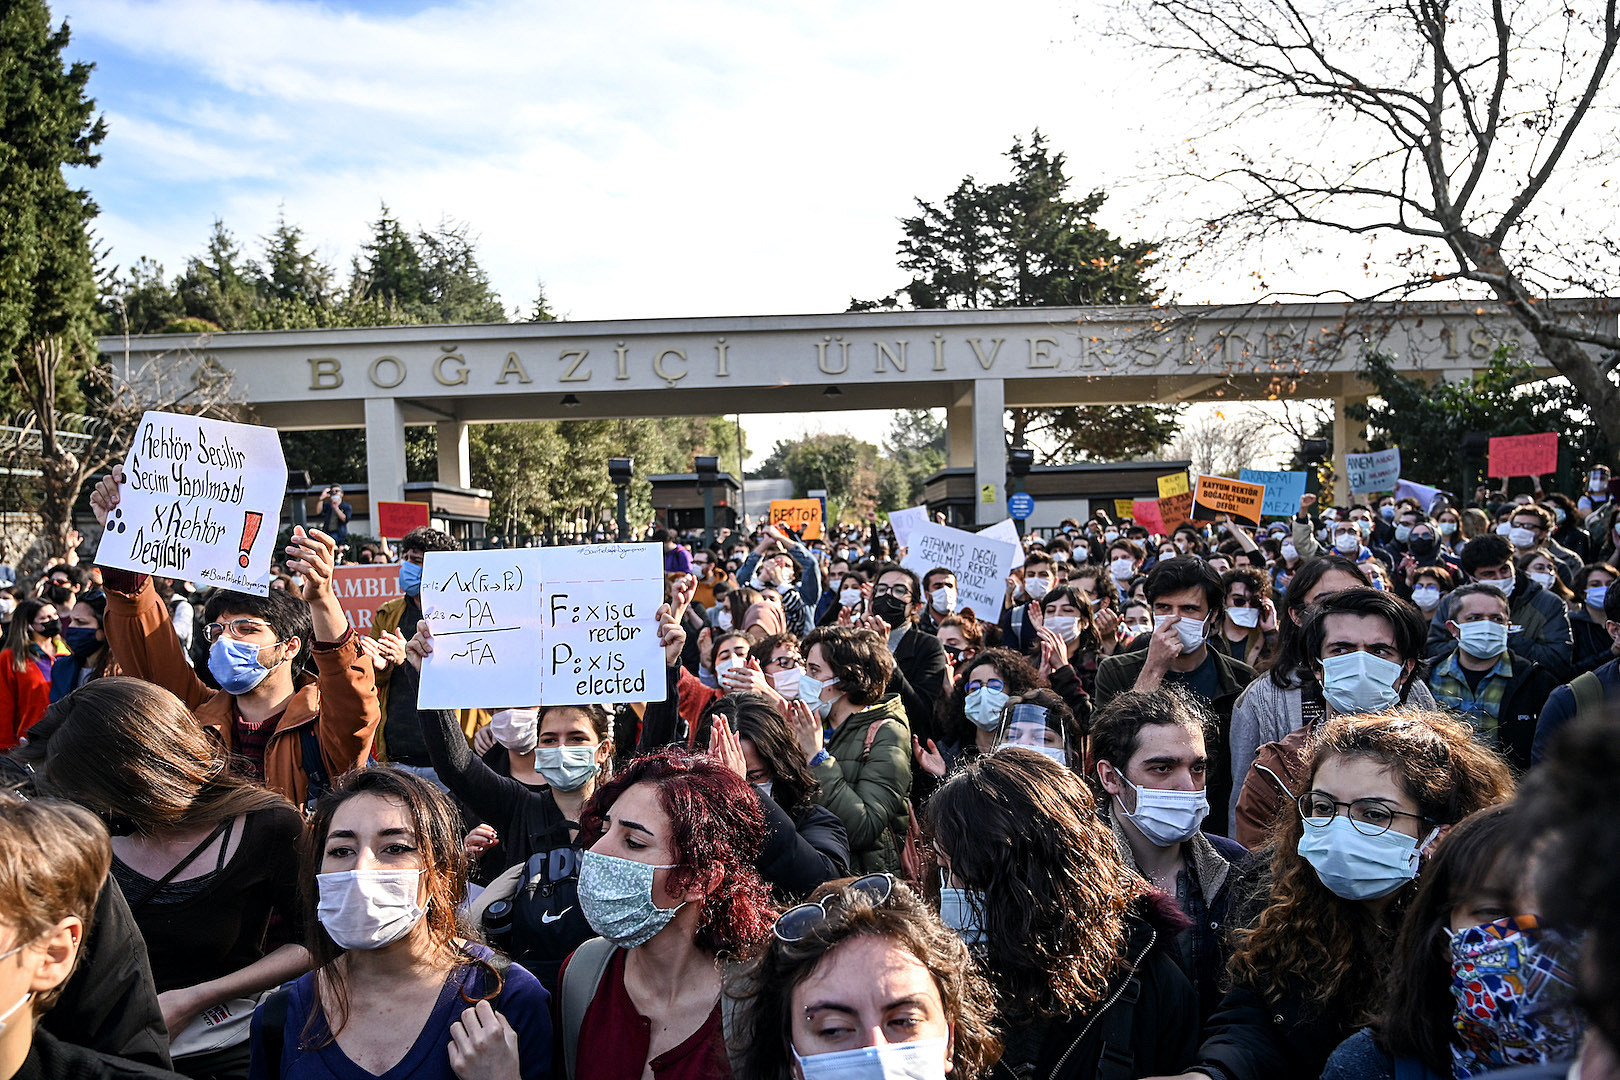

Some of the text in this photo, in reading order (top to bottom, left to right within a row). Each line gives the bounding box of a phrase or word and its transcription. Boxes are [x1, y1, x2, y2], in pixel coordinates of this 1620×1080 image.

[306, 329, 1352, 391] BOĞAZİÇİ ÜNİVERSİTES
[141, 422, 246, 469] Rektör Seçilir
[131, 453, 245, 506] Seçim Yapılmadı
[1202, 480, 1230, 491] KAYYUM
[1231, 485, 1258, 497] REKTÖR
[1216, 500, 1239, 512] DEFOL!
[1263, 501, 1295, 514] MEZ!
[129, 526, 191, 573] Değildir
[920, 535, 965, 559] ATANMIŞ
[971, 547, 998, 568] DEĞİL
[968, 561, 998, 580] REKTÖR
[586, 605, 600, 622] x
[605, 601, 620, 622] is
[623, 602, 636, 619] a
[588, 621, 642, 643] rector
[588, 655, 602, 672] x
[606, 651, 625, 672] is
[576, 669, 645, 696] elected
